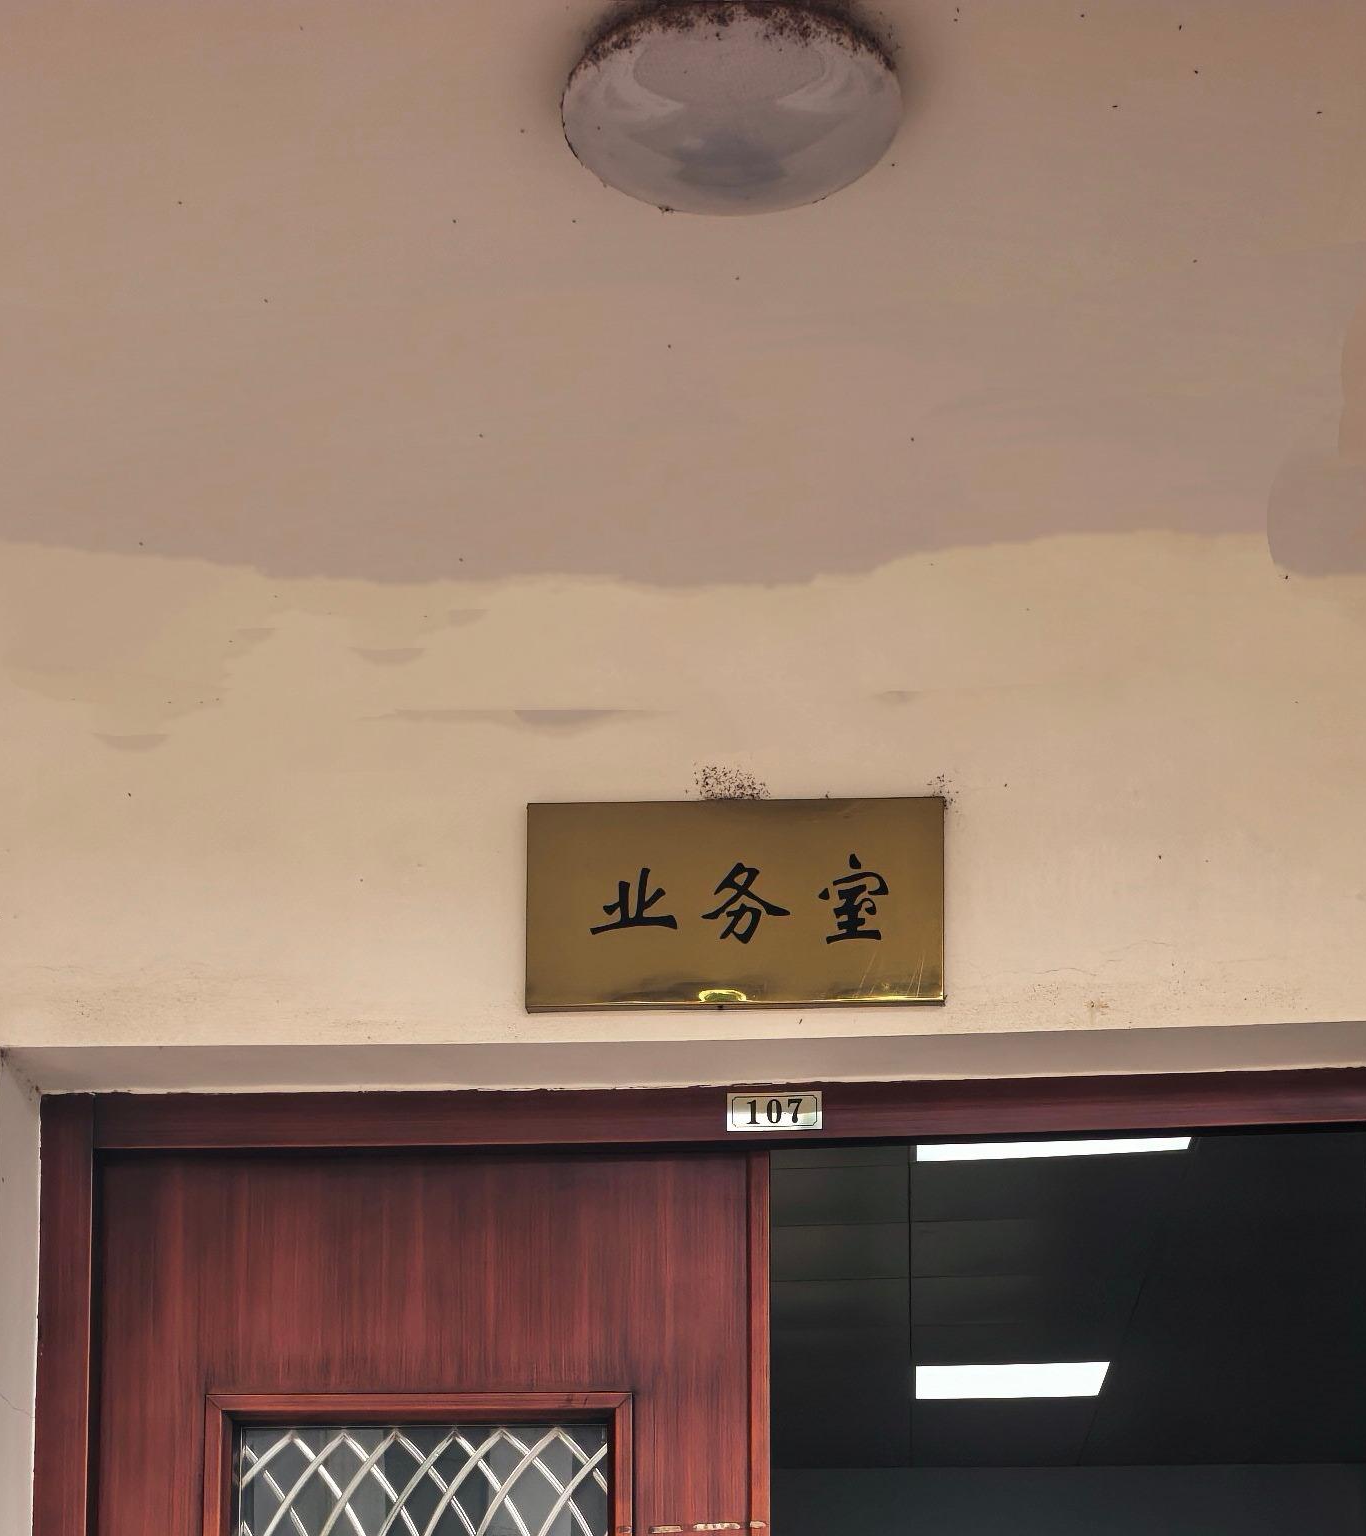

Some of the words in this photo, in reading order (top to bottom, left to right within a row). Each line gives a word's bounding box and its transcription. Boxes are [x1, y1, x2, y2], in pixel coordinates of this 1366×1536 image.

[590, 853, 890, 946] 业务室
[745, 1097, 804, 1126] 107
